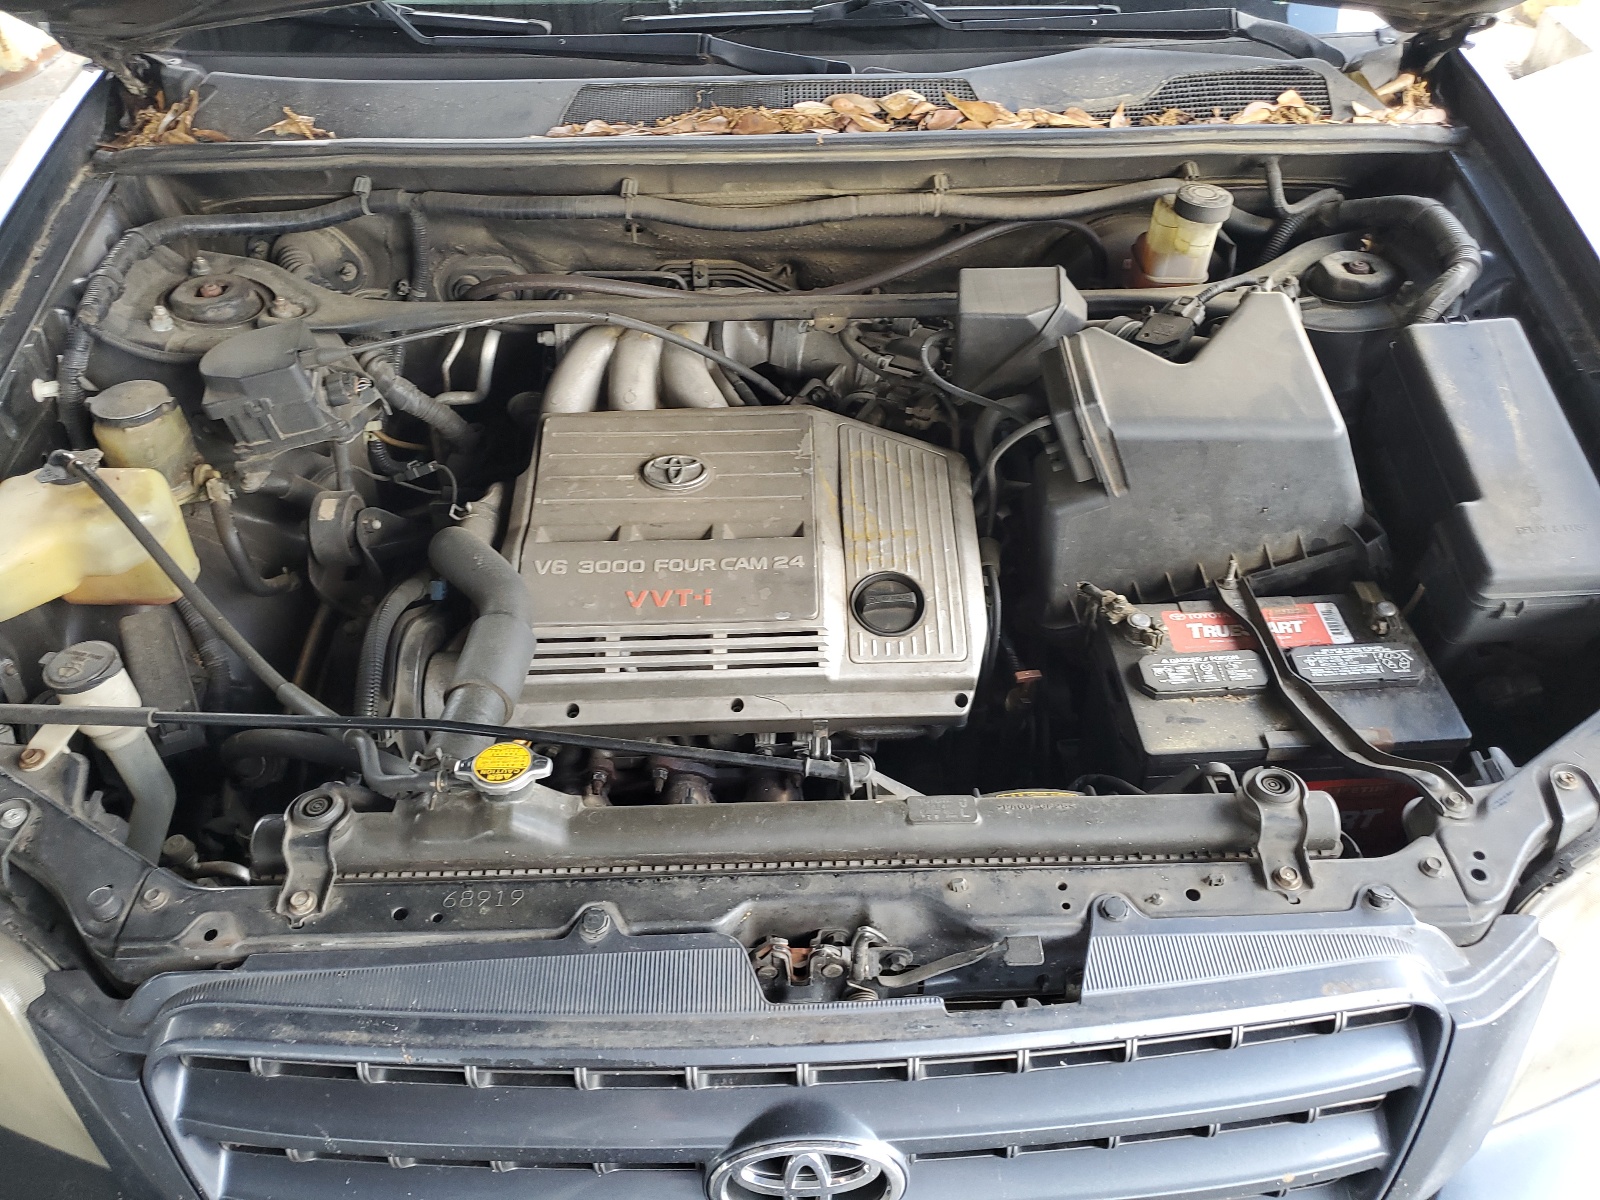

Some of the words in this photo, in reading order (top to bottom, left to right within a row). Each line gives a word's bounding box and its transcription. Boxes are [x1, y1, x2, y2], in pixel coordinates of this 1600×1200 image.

[533, 559, 568, 575] V6
[577, 559, 645, 574] 3000
[653, 557, 717, 573] FOUR
[719, 556, 768, 571] CAM
[772, 555, 805, 570] 24
[624, 588, 713, 608] VVT-i
[1185, 612, 1231, 620] TOYOTA
[442, 889, 525, 908] 68919
